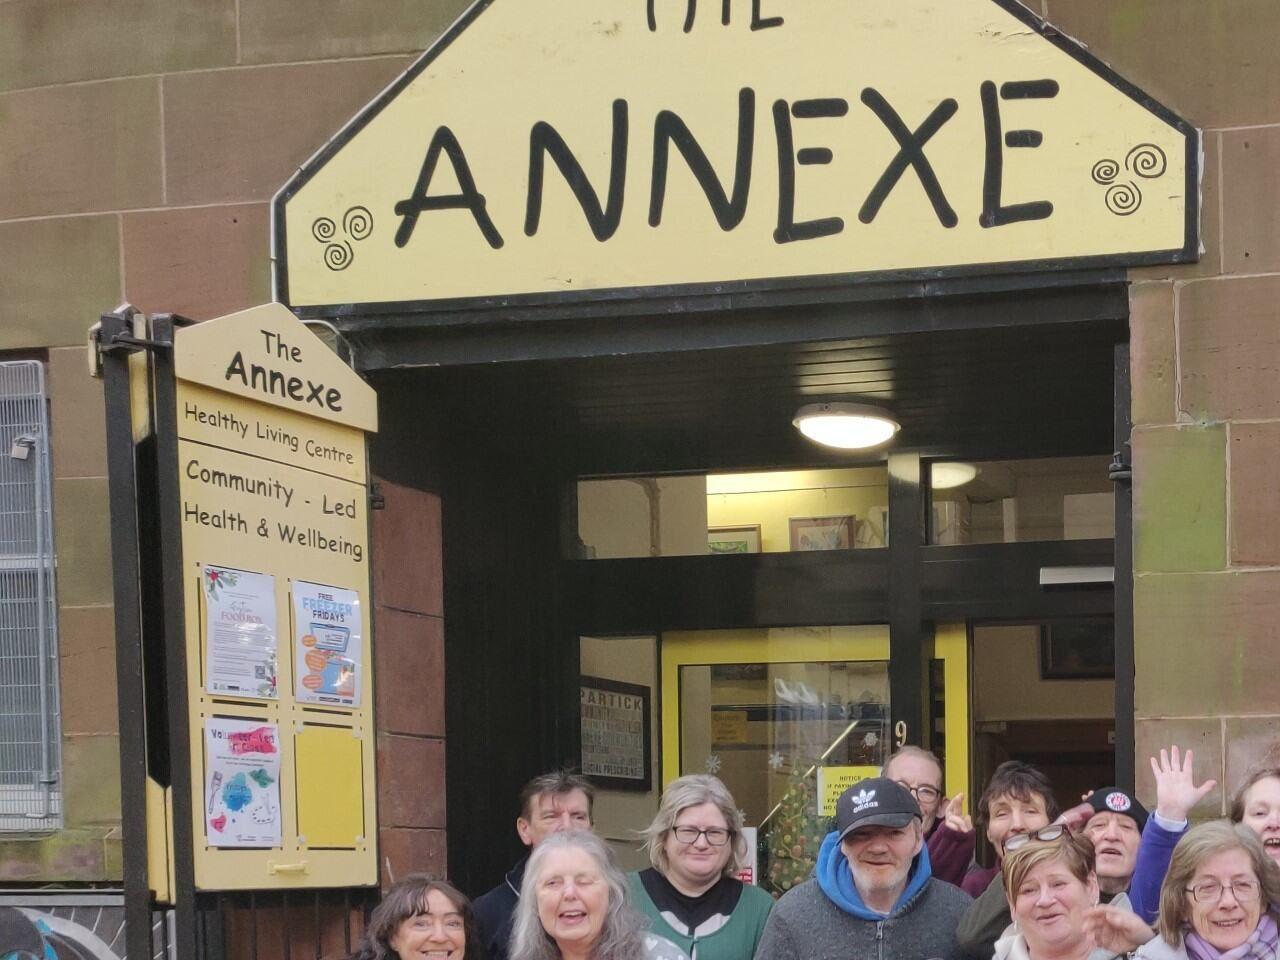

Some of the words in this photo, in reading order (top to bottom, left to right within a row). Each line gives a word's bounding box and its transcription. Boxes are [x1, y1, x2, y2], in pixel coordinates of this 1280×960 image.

[394, 78, 1060, 249] ANNEXE
[260, 329, 303, 363] The
[225, 351, 342, 412] Annexe
[185, 401, 248, 439] Healthy
[256, 421, 299, 452] Living
[305, 440, 355, 465] Centre
[187, 460, 293, 507] Community
[322, 494, 356, 519] Led
[185, 502, 248, 534] Health
[256, 518, 269, 538] &
[278, 522, 363, 562] Wellbeing
[302, 597, 352, 616] FREEZER
[318, 593, 333, 601] FREE
[312, 609, 345, 623] FRIDAYS
[580, 687, 641, 711] PARTICK
[895, 720, 907, 747] 9
[853, 801, 878, 813] adidas
